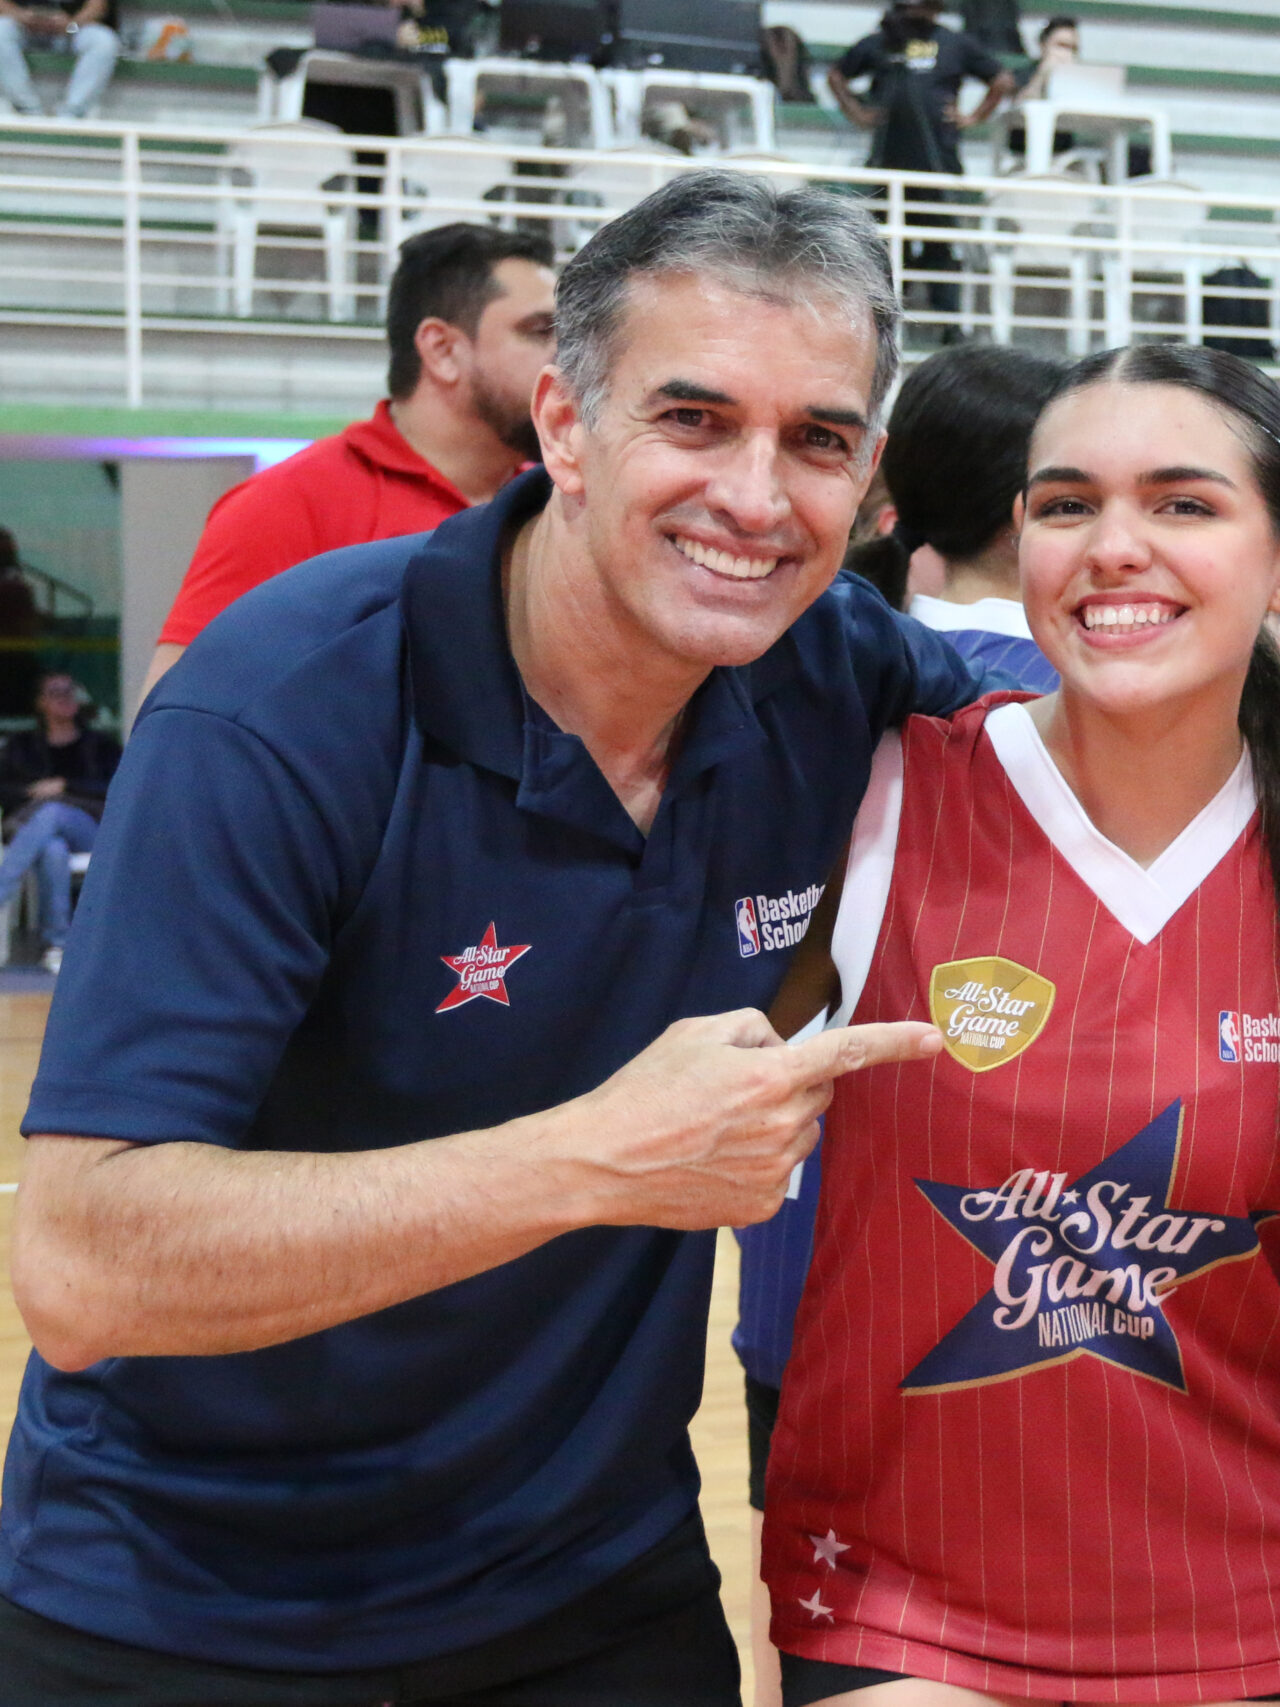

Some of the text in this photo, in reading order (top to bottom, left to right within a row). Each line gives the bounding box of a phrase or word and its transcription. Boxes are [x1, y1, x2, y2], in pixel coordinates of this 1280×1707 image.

[756, 884, 826, 923] Basketb
[460, 964, 505, 991] Game
[947, 1003, 1020, 1037] Game
[960, 1031, 1006, 1049] NATIONAL CUP
[992, 1225, 1179, 1331] Game
[1037, 1302, 1155, 1348] NATIONAL CUP
